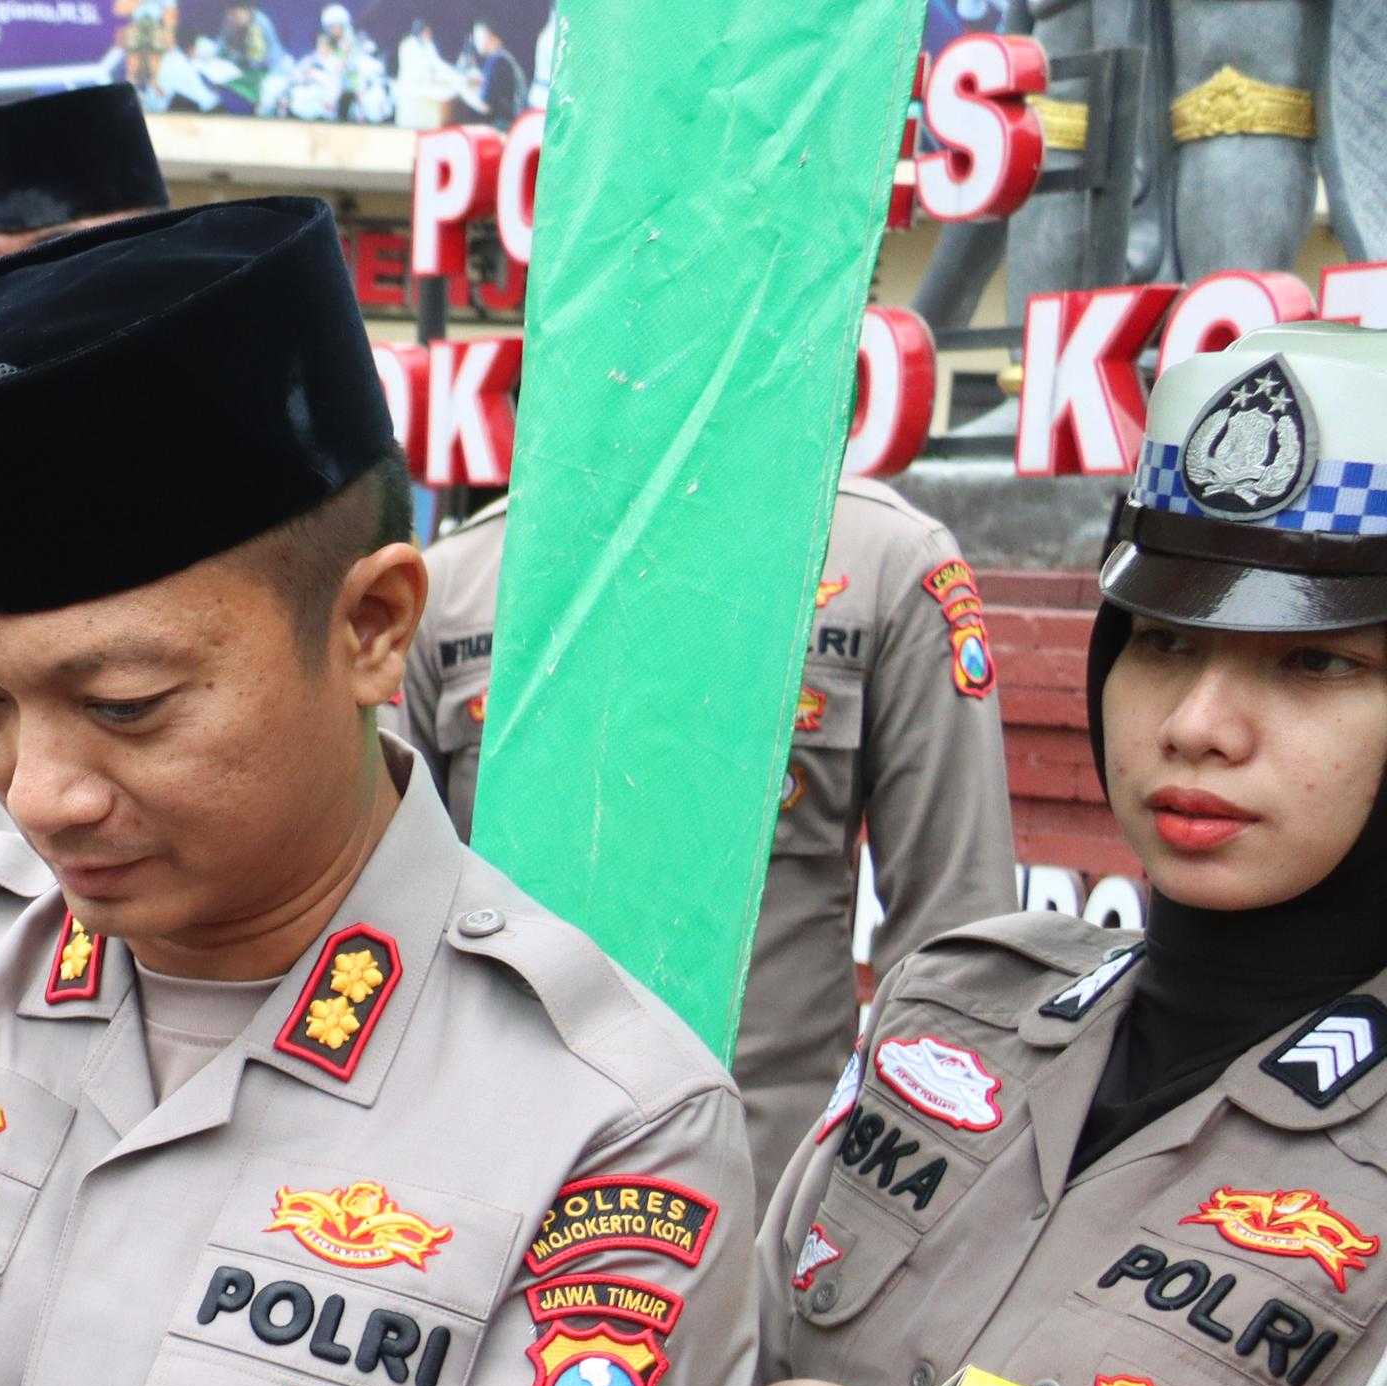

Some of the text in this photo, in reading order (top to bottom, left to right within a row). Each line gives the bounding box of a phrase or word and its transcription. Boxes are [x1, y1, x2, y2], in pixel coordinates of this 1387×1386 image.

[541, 1188, 688, 1233] POLRES
[531, 1213, 694, 1260] MOJOKERTO KOTA
[539, 1284, 669, 1320] JAWA TIMUR
